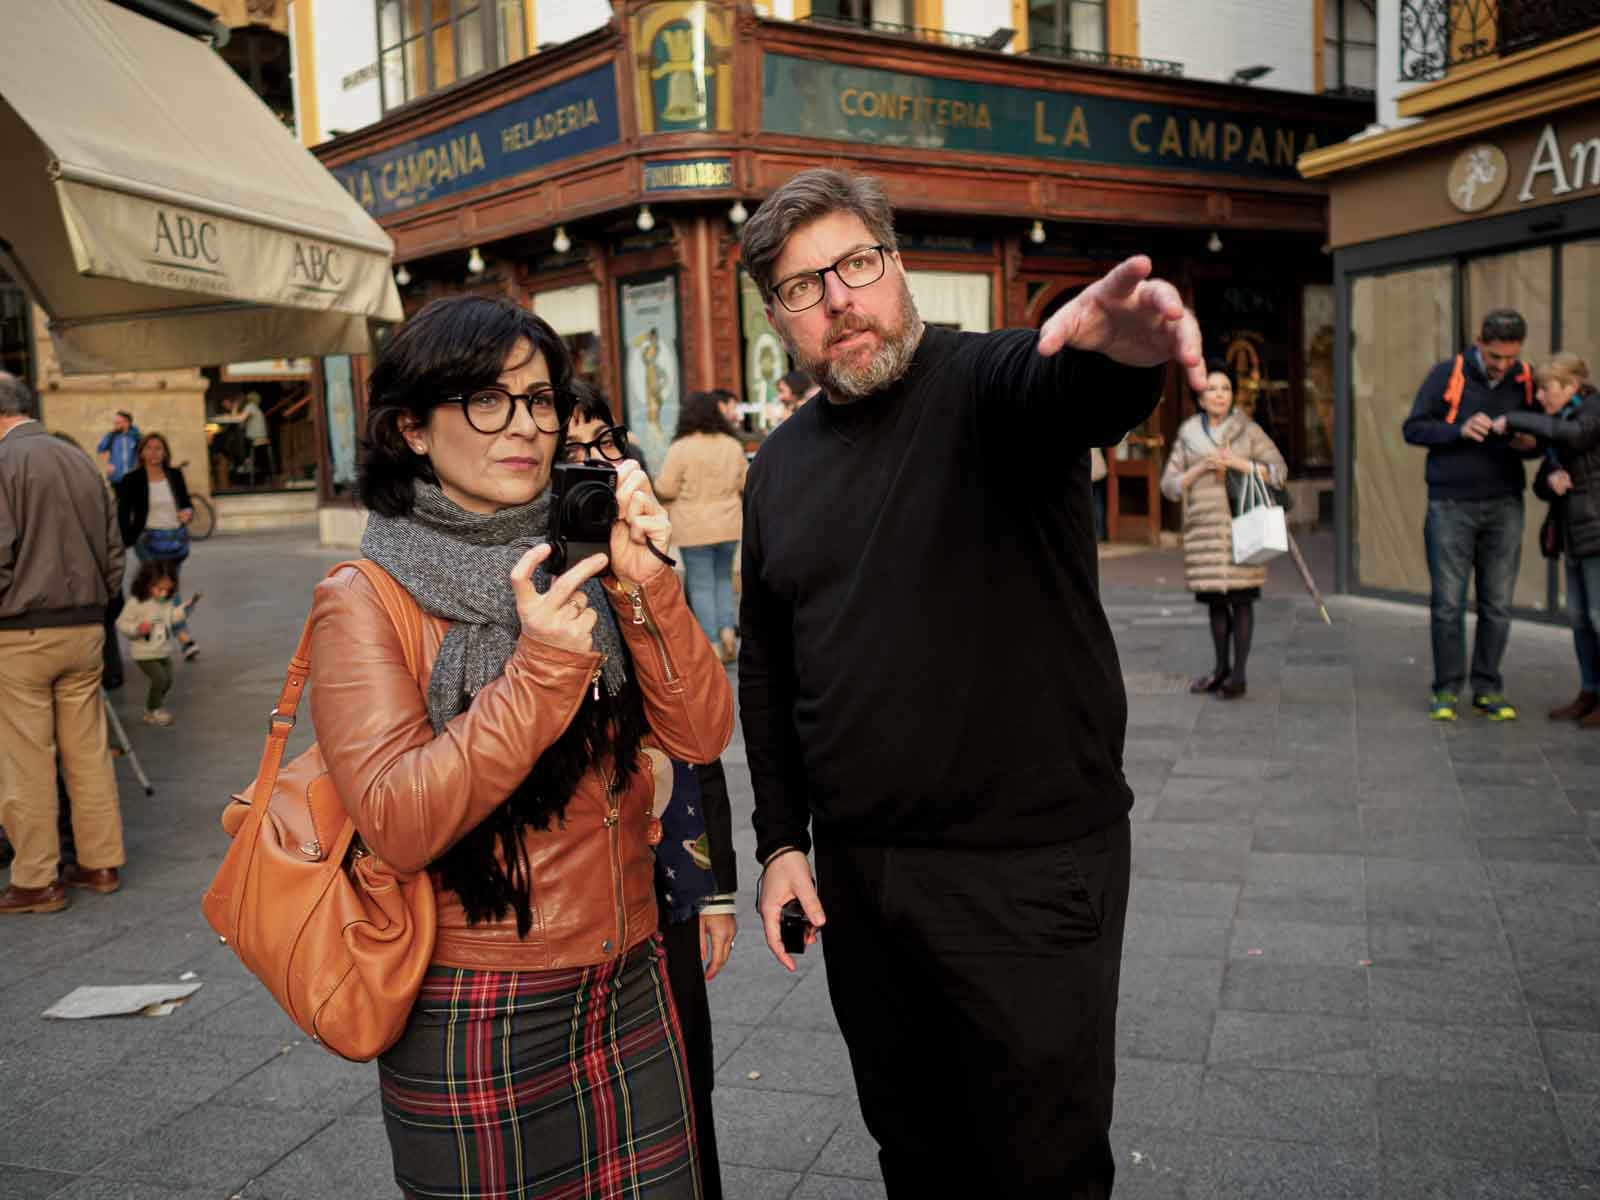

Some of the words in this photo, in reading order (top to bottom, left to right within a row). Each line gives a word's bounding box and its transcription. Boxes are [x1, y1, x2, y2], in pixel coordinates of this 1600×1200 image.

[839, 88, 992, 131] CONFITERIA
[1034, 101, 1090, 148] LA
[380, 131, 485, 199] CAMPANA
[501, 98, 599, 154] HELADERIA
[154, 210, 219, 264] ABC
[293, 241, 343, 285] ABC
